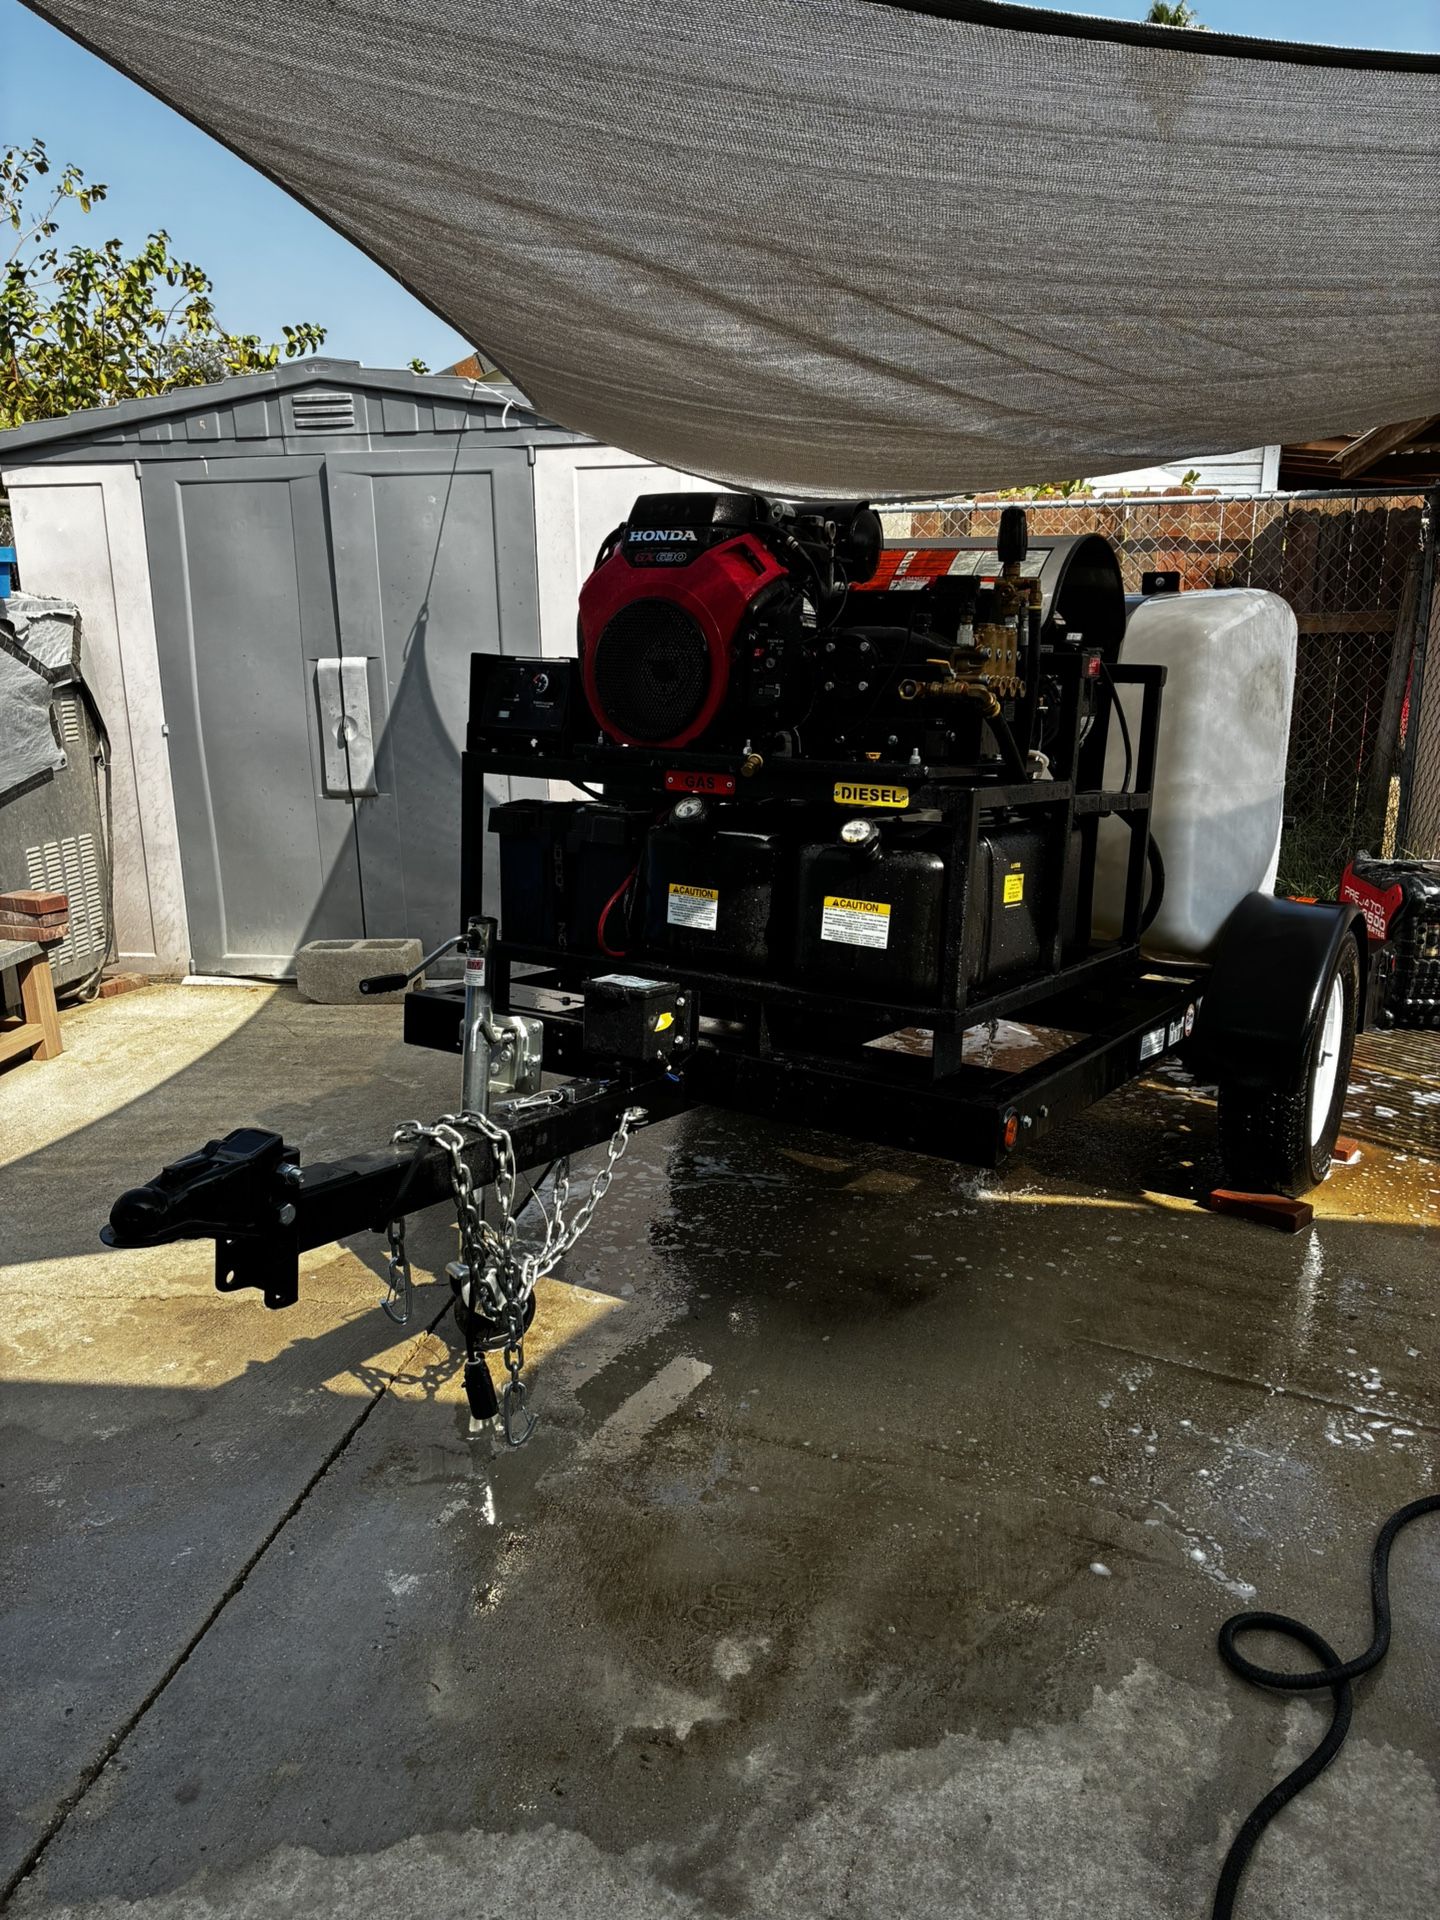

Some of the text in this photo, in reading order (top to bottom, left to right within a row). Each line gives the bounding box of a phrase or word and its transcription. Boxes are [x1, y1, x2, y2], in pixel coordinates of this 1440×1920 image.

[628, 530, 698, 542] HONDA
[685, 776, 716, 789] GAS
[841, 786, 901, 803] DIESEL
[679, 886, 714, 899] CAUTION
[839, 899, 880, 912] CAUTION
